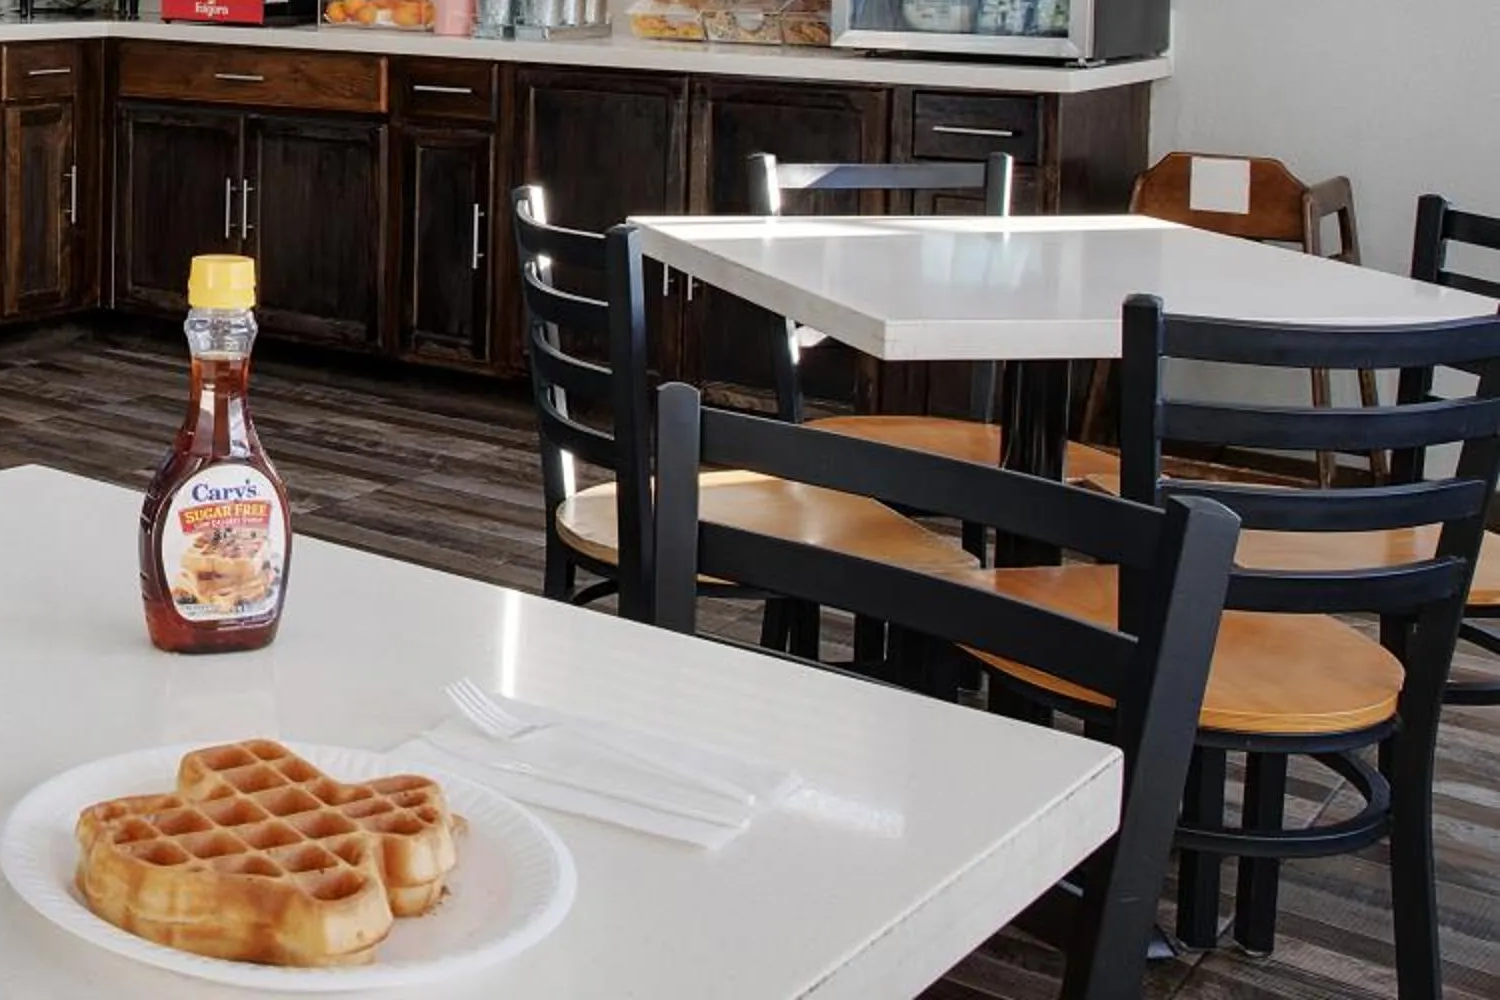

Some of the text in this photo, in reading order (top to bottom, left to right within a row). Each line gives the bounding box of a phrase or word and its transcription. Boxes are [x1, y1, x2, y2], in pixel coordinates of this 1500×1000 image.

[191, 479, 257, 503] Cary's
[185, 503, 268, 522] SUGAR FREE
